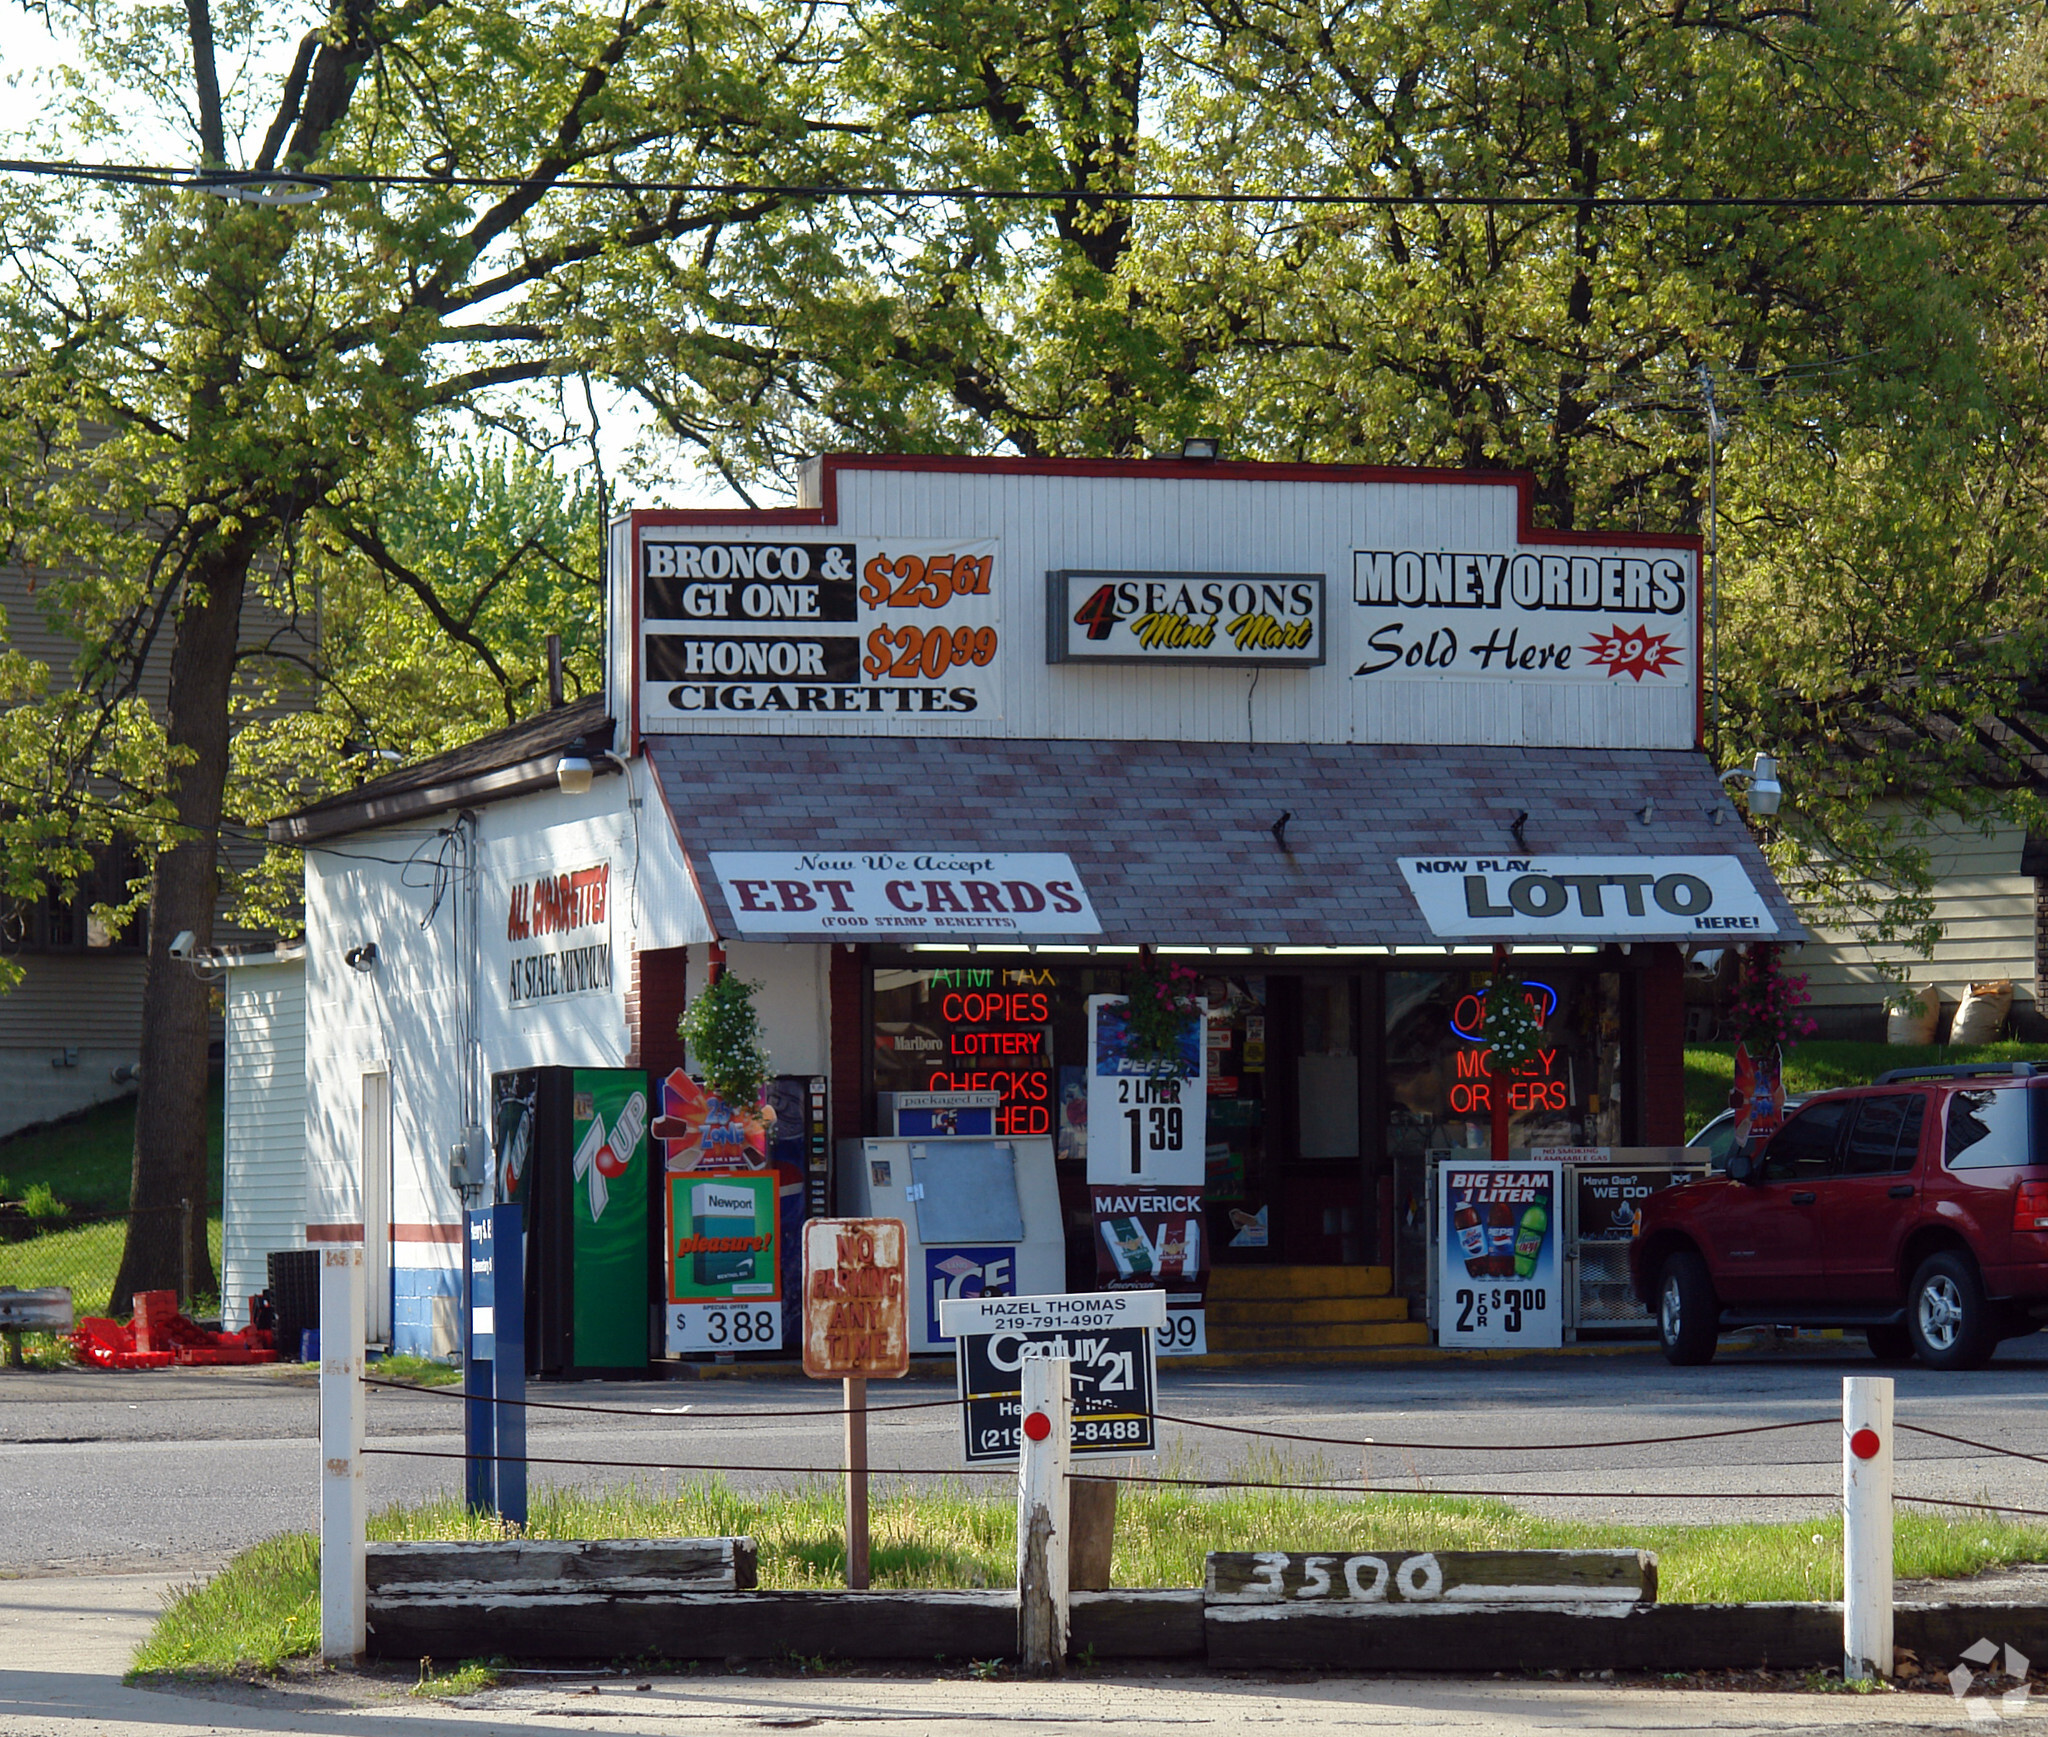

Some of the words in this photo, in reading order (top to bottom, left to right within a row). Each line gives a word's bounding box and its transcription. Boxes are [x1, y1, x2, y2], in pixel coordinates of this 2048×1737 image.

[648, 545, 810, 579] BRONCO
[821, 547, 853, 580] &
[1354, 551, 1507, 609] MONEY
[1509, 553, 1685, 614] ORDERS
[683, 583, 732, 617] GT
[741, 584, 820, 617] ONE
[1074, 583, 1127, 641] 4
[1116, 582, 1314, 616] SEASONS
[1132, 613, 1215, 650] Mini
[1227, 614, 1313, 651] Mart
[684, 641, 827, 676] HONOR
[1354, 622, 1456, 676] Sold
[1470, 627, 1571, 670] Here
[1600, 638, 1664, 666] 39¢
[668, 685, 978, 712] CIGARETTES
[795, 855, 856, 871] Now
[862, 855, 906, 871] We
[913, 855, 995, 875] Accept
[1416, 860, 1467, 873] NOW
[729, 879, 855, 912] EBT
[885, 879, 1083, 913] CARDS
[1464, 873, 1713, 918] LOTTO
[508, 882, 530, 942] ALL
[822, 916, 867, 928] (FOOD
[875, 916, 927, 928] STAMP
[934, 917, 1017, 929] BENEFITS)
[1695, 916, 1760, 929] HERE!
[509, 958, 523, 1001] AT
[524, 953, 558, 1000] STATE
[560, 943, 609, 993] MINIMUM
[931, 968, 991, 988] ATM
[943, 993, 1048, 1021] COPIES
[894, 1035, 943, 1051] Marlboro
[951, 1033, 1041, 1054] LOTTERY
[904, 1093, 970, 1106] packaged
[975, 1095, 995, 1104] ice
[1118, 1079, 1129, 1104] 2
[1135, 1079, 1181, 1105] LITER
[1451, 1081, 1566, 1112] ORERS
[1452, 1174, 1490, 1187] BIG
[1493, 1174, 1549, 1188] SLAM
[1583, 1176, 1608, 1185] Have
[1612, 1176, 1638, 1185] Gas?
[1593, 1187, 1619, 1198] WE
[709, 1195, 752, 1210] Newport
[1095, 1196, 1203, 1214] MAVERICK
[1464, 1189, 1473, 1202] 1
[1478, 1189, 1535, 1202] LITER
[677, 1232, 772, 1258] pleasure!
[836, 1234, 874, 1263] NO
[813, 1269, 899, 1298] PARKING
[831, 1302, 881, 1329] ANY
[981, 1303, 1041, 1316] HAZEL
[1046, 1299, 1126, 1314] THOMAS
[1456, 1289, 1474, 1332] 2
[677, 1313, 686, 1330] $
[995, 1314, 1114, 1329] 219-791-4907
[825, 1333, 889, 1360] TIME
[987, 1331, 1109, 1372] Century
[1098, 1351, 1135, 1392] 21
[1242, 1552, 1443, 1600] 3500
